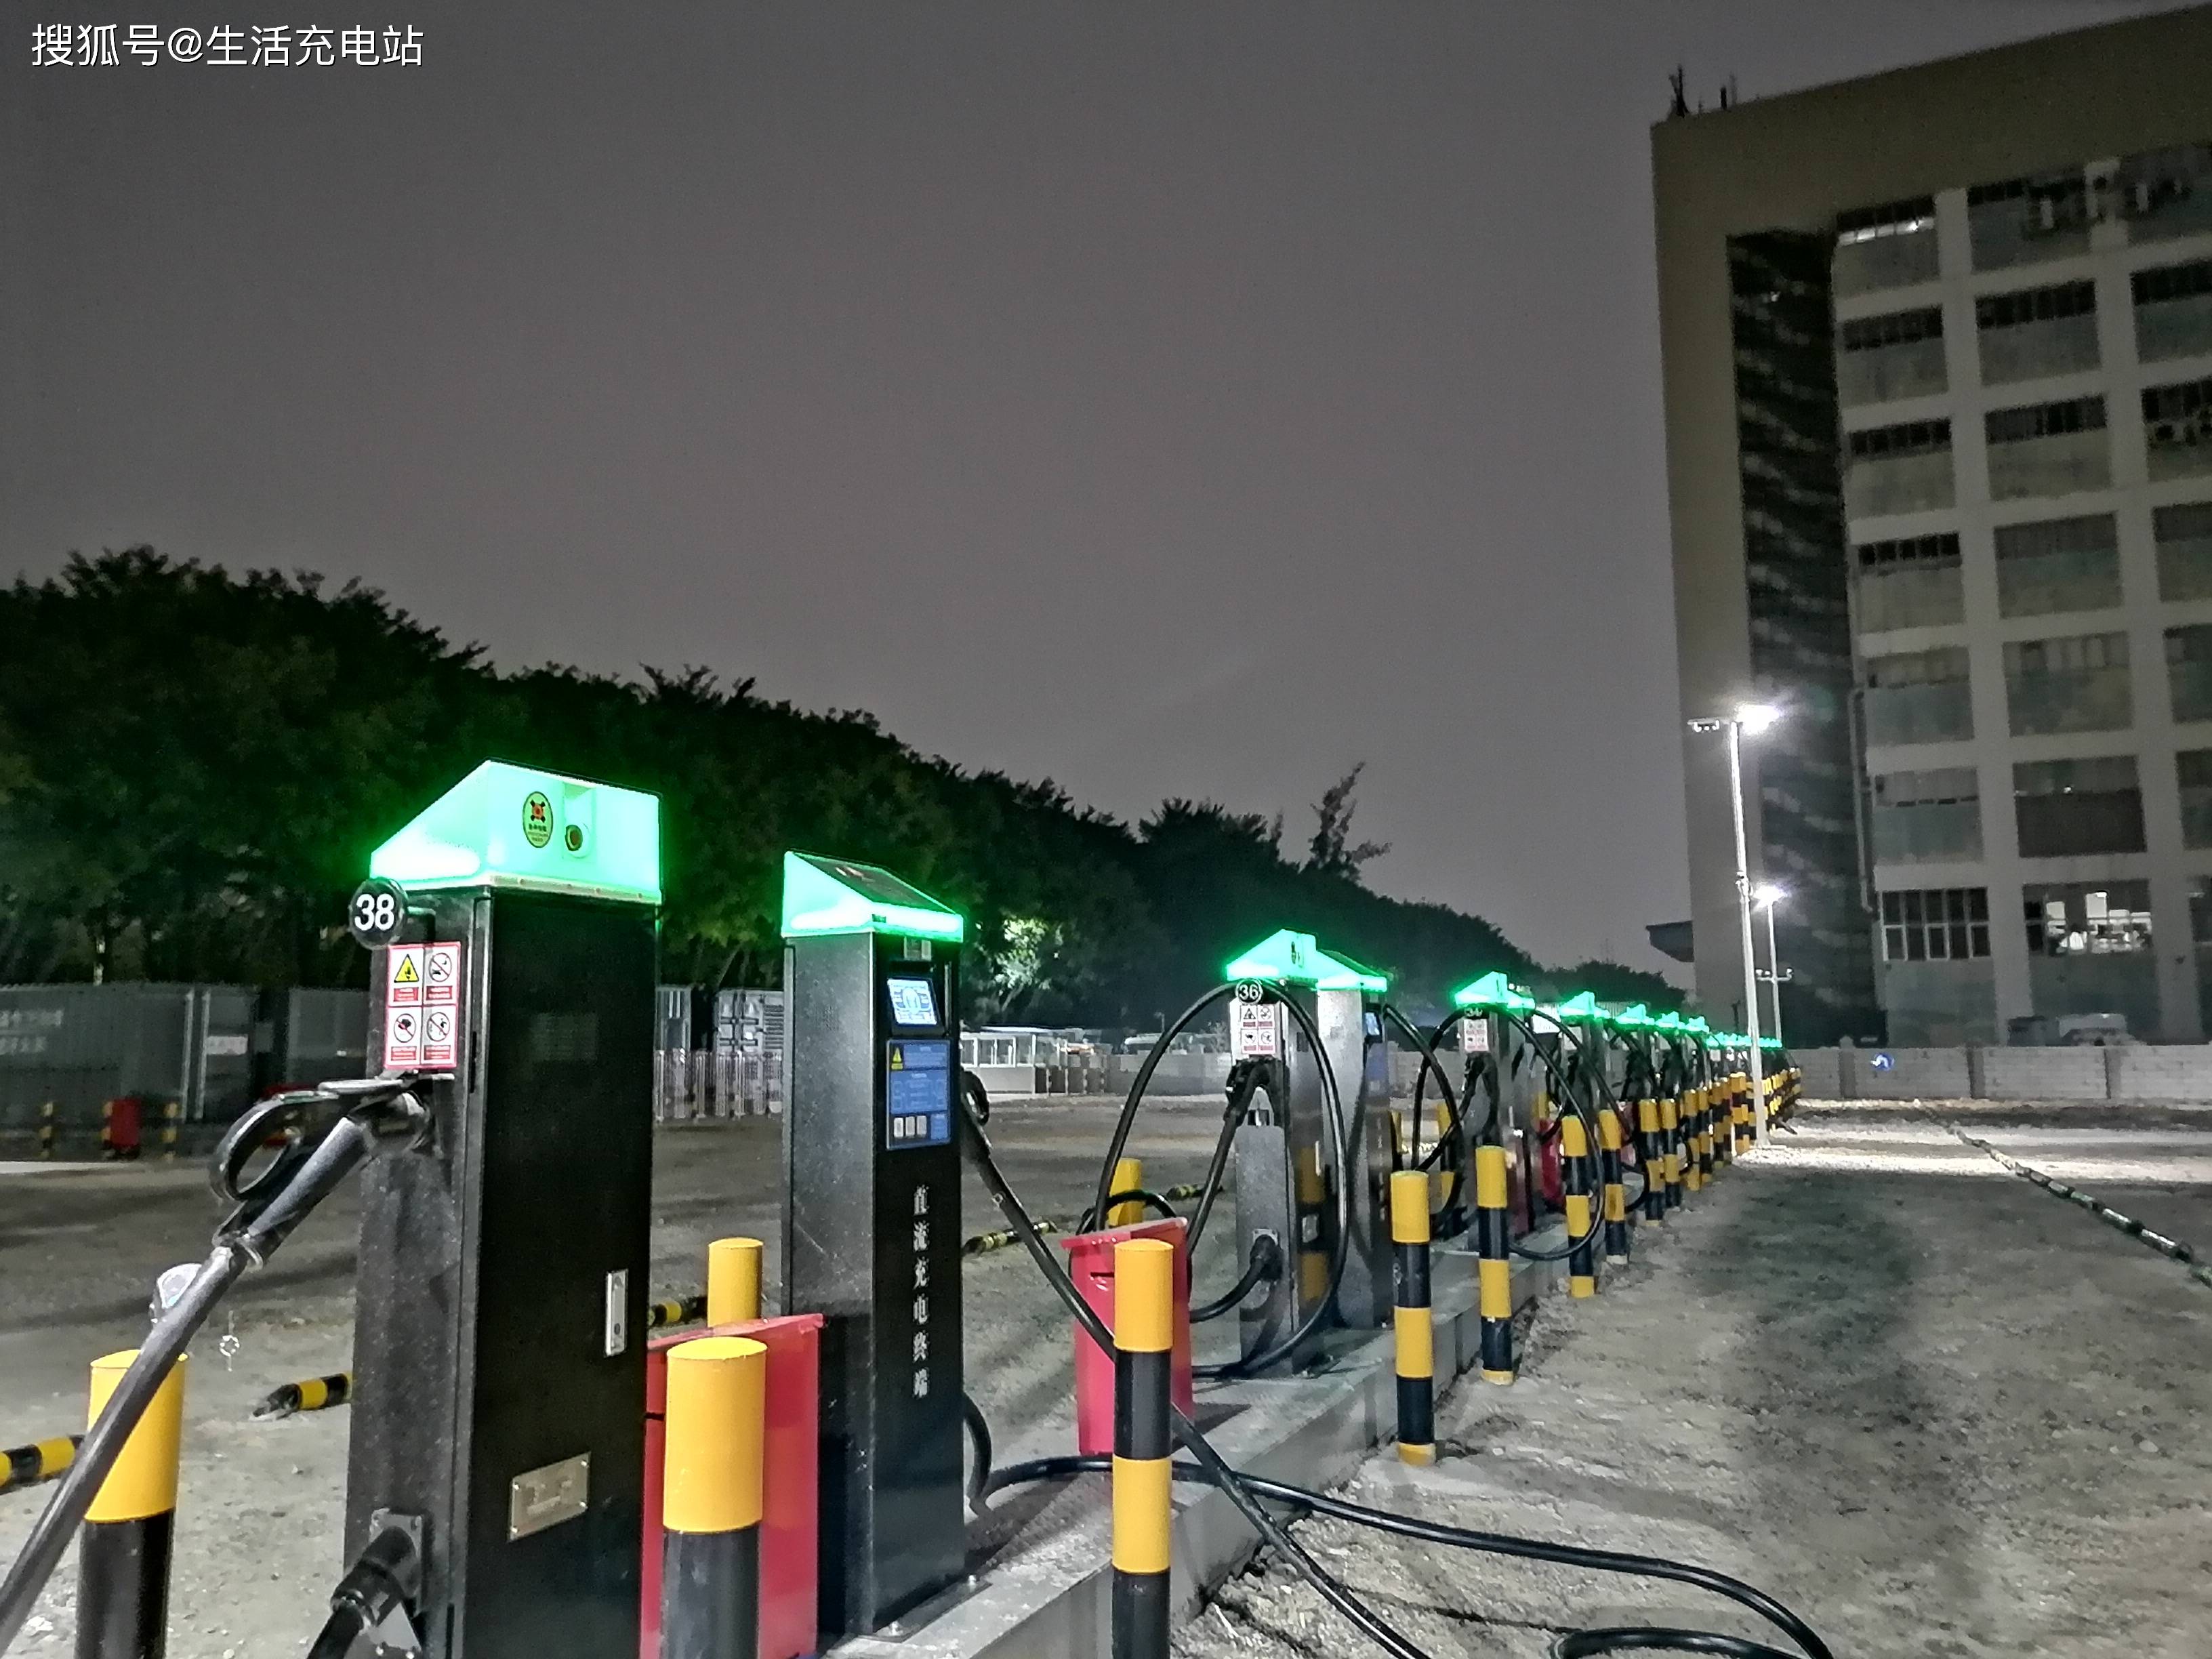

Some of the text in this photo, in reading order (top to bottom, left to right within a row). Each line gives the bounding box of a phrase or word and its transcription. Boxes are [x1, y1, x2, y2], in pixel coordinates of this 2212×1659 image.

[354, 893, 395, 931] 38
[1238, 985, 1259, 1000] 36
[913, 1185, 930, 1399] 直流充电终端
